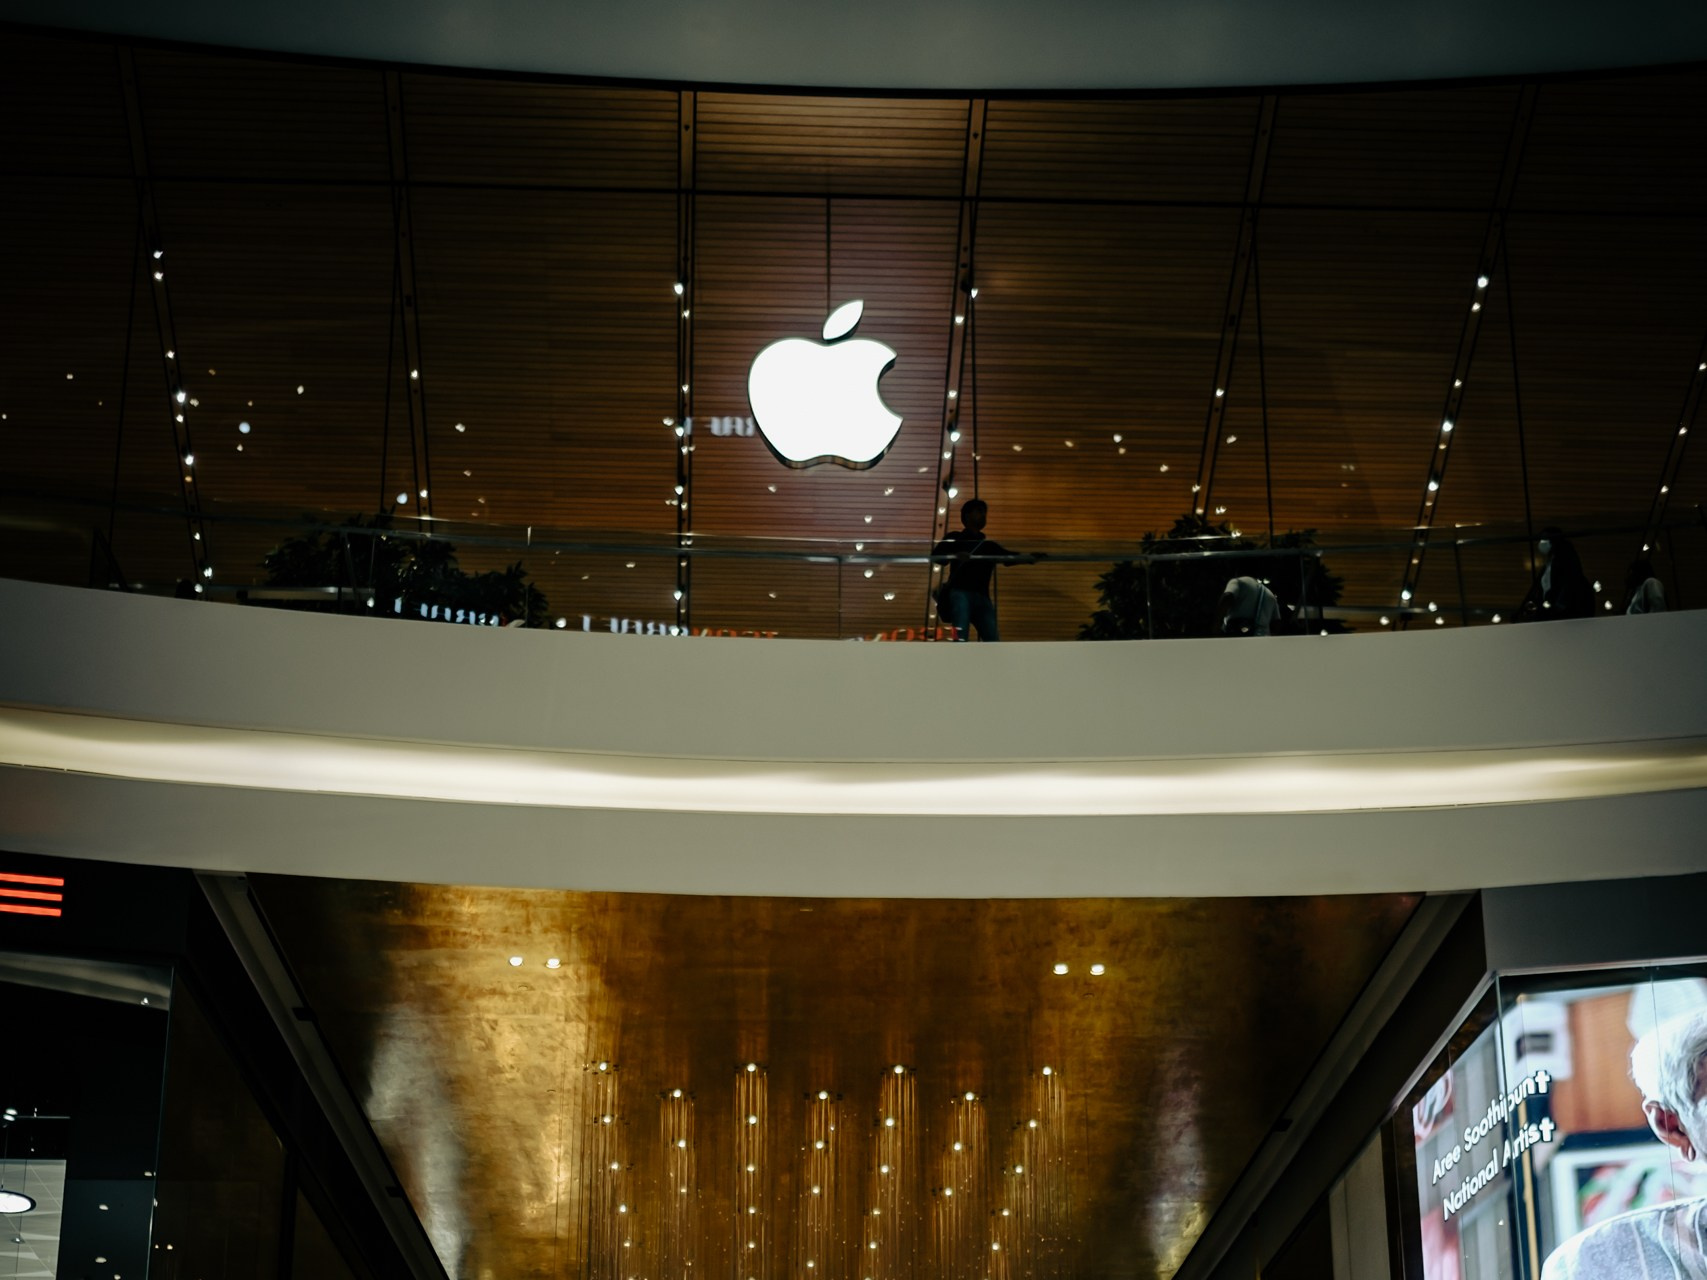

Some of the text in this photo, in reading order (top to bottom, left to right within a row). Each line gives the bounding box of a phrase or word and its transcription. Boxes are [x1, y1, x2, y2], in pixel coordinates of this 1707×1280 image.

[1432, 1145, 1461, 1185] Aree
[1443, 1116, 1555, 1222] National Artist
